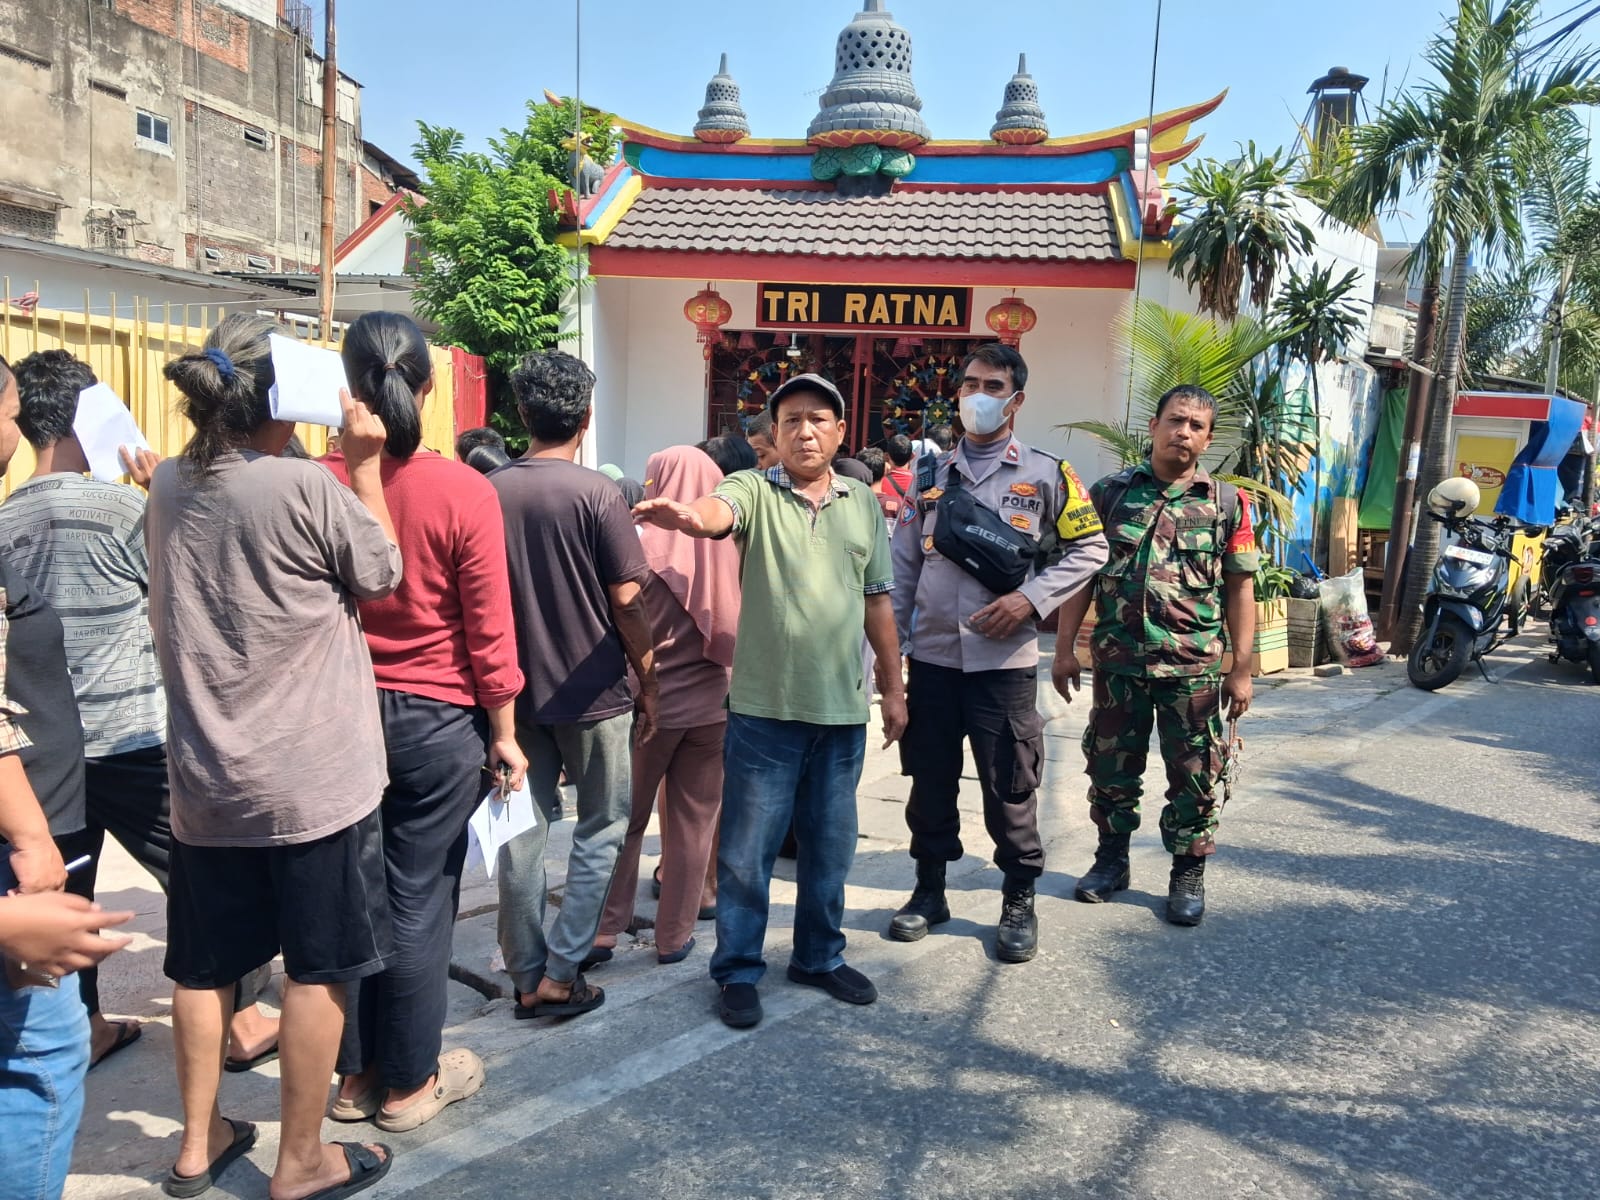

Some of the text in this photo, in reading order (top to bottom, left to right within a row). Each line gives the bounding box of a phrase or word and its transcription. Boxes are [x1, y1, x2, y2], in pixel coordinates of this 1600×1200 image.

[763, 290, 819, 322] TRI
[844, 292, 958, 325] RATNA
[81, 489, 118, 502] SUCCESS
[1001, 496, 1041, 512] POLRI
[68, 508, 113, 523] MOTIVATE
[65, 530, 101, 543] HARDER
[965, 525, 1021, 555] EIGER
[64, 587, 105, 597] MOTIVATE
[73, 627, 106, 640] HARDER
